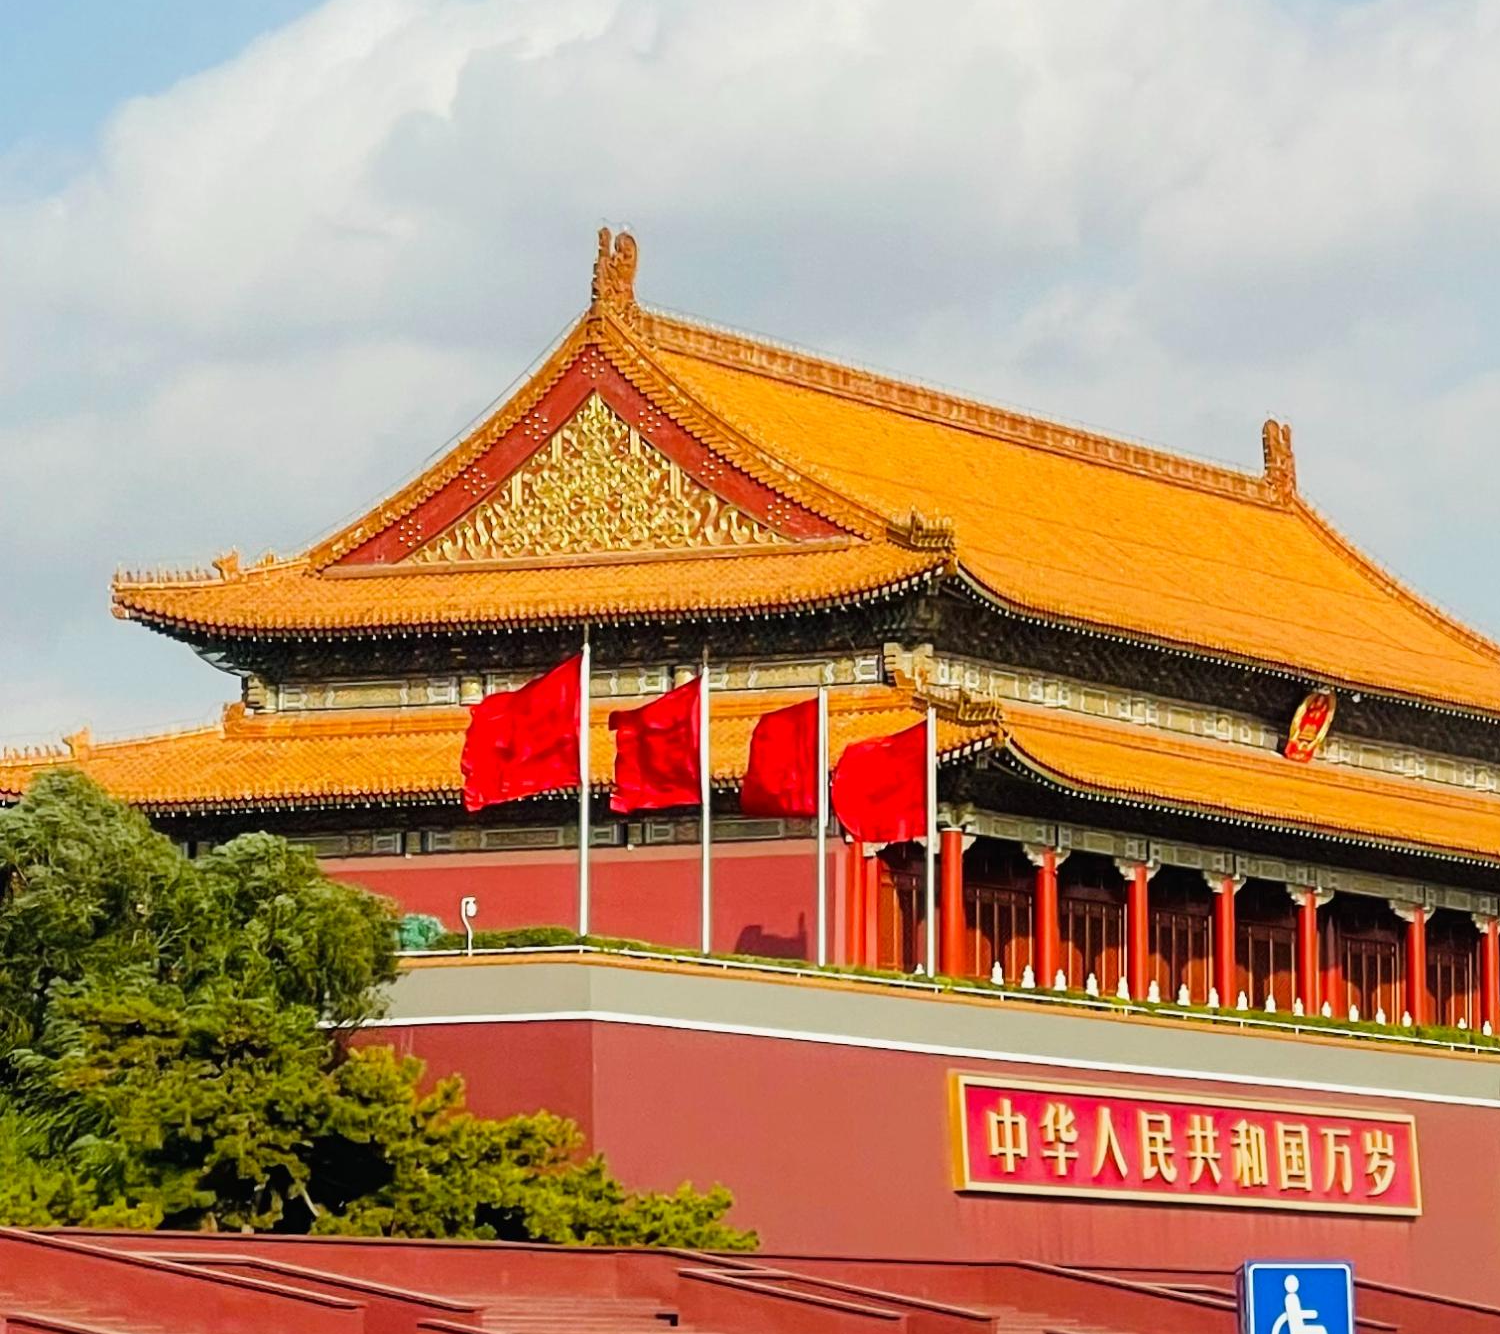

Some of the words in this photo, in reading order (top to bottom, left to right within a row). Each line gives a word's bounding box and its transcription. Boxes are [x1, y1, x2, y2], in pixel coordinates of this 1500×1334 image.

[988, 1099, 1397, 1197] 中华人民共和国万岁
